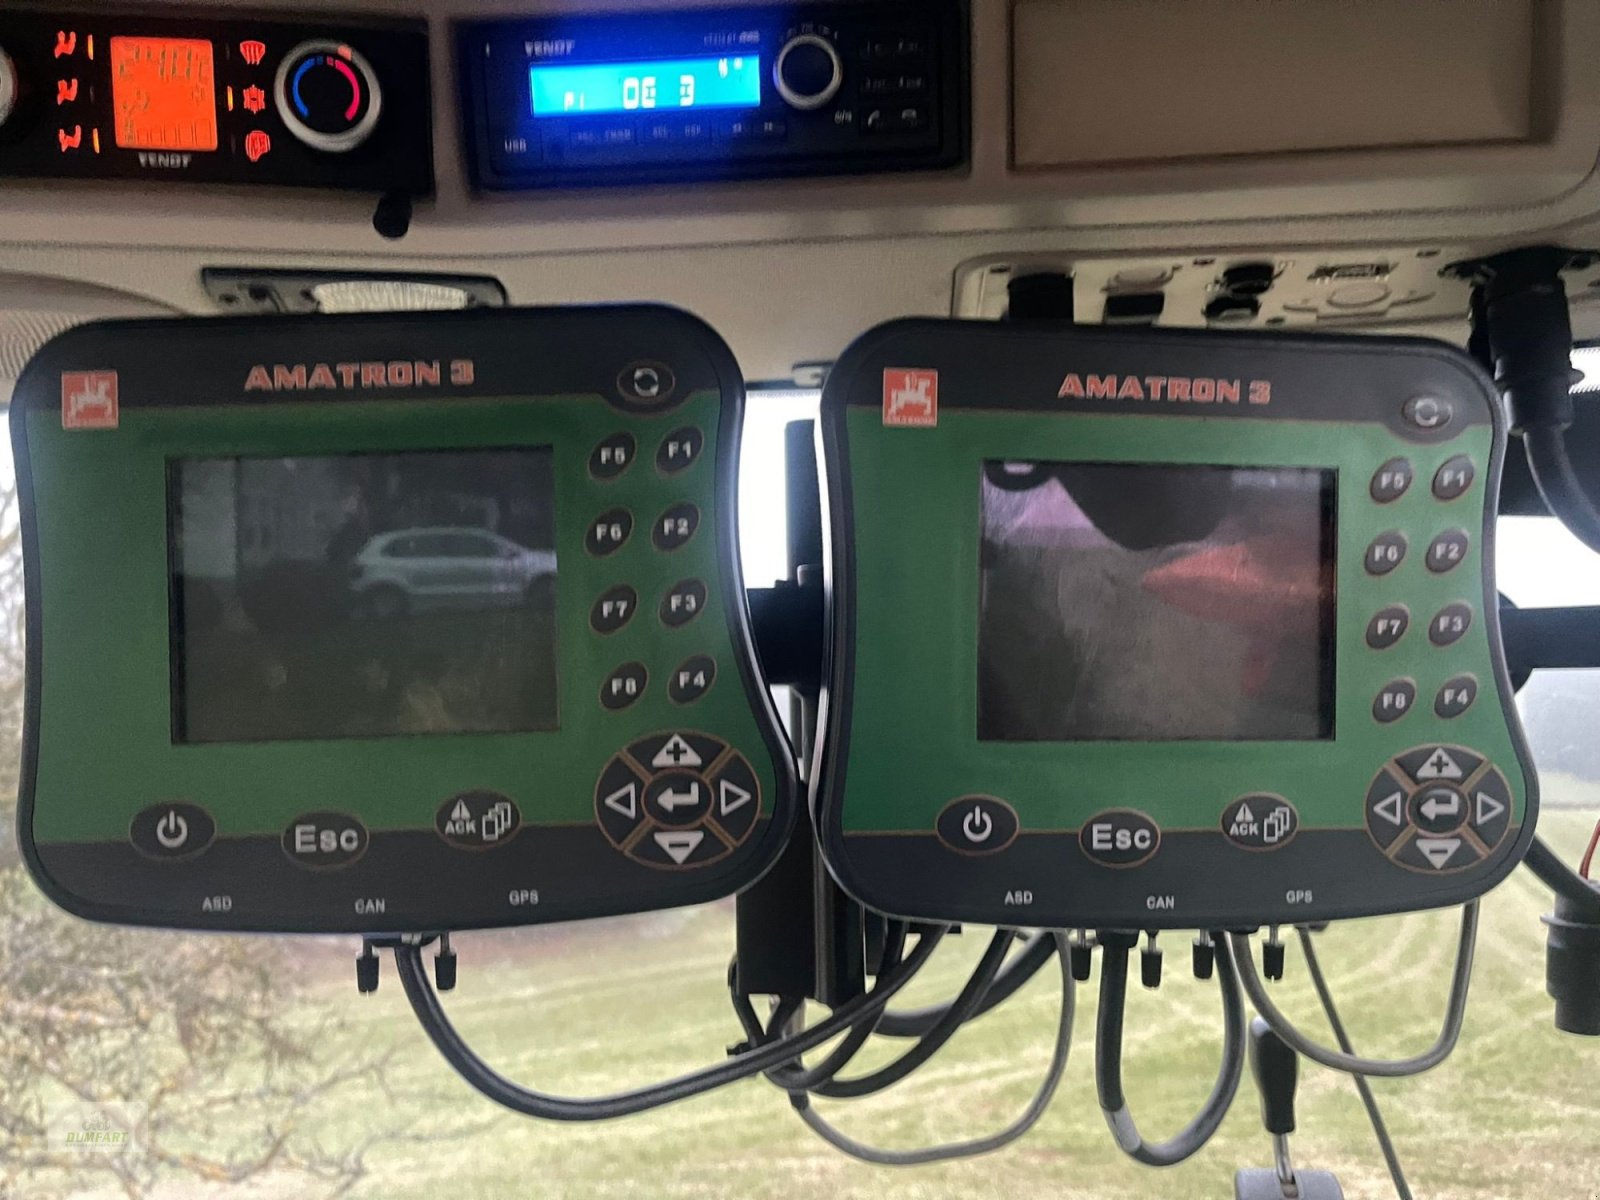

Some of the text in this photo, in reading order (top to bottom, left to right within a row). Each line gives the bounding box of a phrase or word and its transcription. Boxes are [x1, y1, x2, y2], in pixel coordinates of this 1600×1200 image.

[244, 359, 475, 391] AMATRON 3
[1058, 373, 1271, 405] AMATRON 3
[601, 447, 626, 465] F5
[668, 440, 692, 458] F1
[1381, 471, 1405, 490] F5
[1443, 470, 1466, 487] F1
[596, 523, 622, 541] F6
[663, 517, 689, 536] F2
[1374, 544, 1399, 562] F6
[1436, 542, 1460, 560] F2
[602, 600, 629, 618] F7
[670, 593, 696, 612] F3
[1377, 617, 1402, 635] F7
[1439, 614, 1463, 632] F3
[611, 677, 637, 696] F8
[679, 670, 706, 688] F4
[1382, 692, 1406, 710] F8
[1444, 687, 1469, 705] F4
[445, 818, 477, 835] ACK
[1229, 822, 1259, 837] ACK
[202, 895, 233, 912] ASD
[508, 888, 540, 906] GPS
[1004, 889, 1034, 906] ASD
[1146, 894, 1175, 911] CAN
[1285, 888, 1313, 904] GPS
[354, 897, 386, 915] CAN
